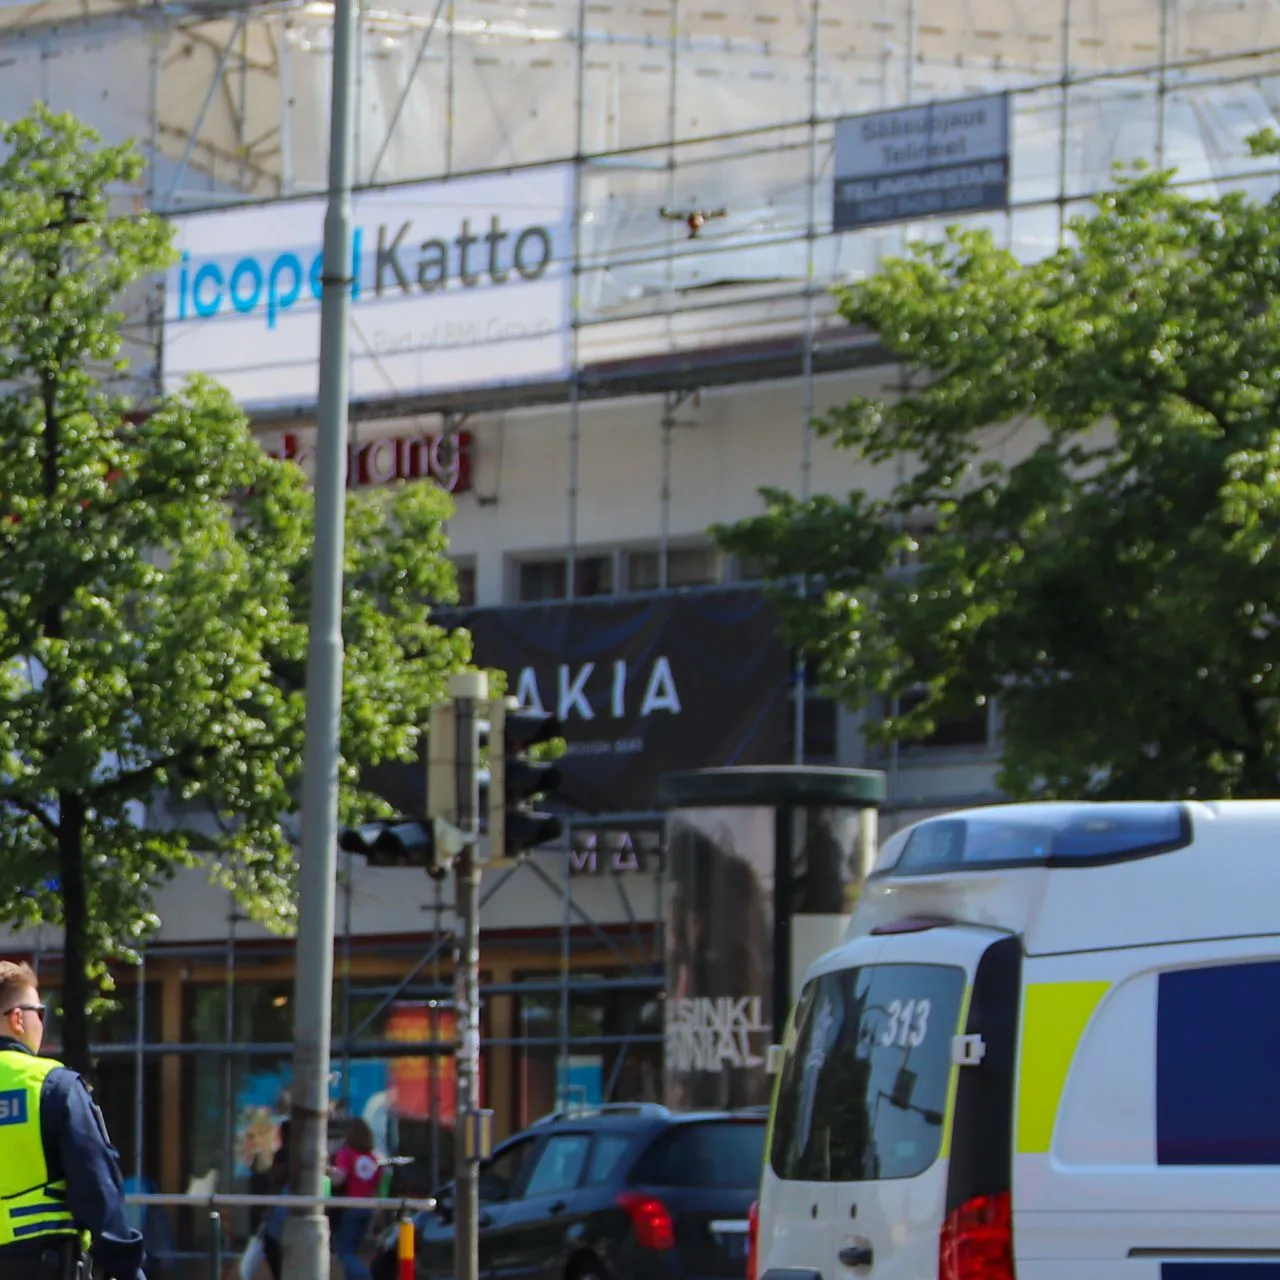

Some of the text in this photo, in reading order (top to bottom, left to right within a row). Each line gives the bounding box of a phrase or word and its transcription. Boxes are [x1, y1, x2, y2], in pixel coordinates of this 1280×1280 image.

[178, 212, 553, 330] icopl Katto
[881, 998, 931, 1048] 313
